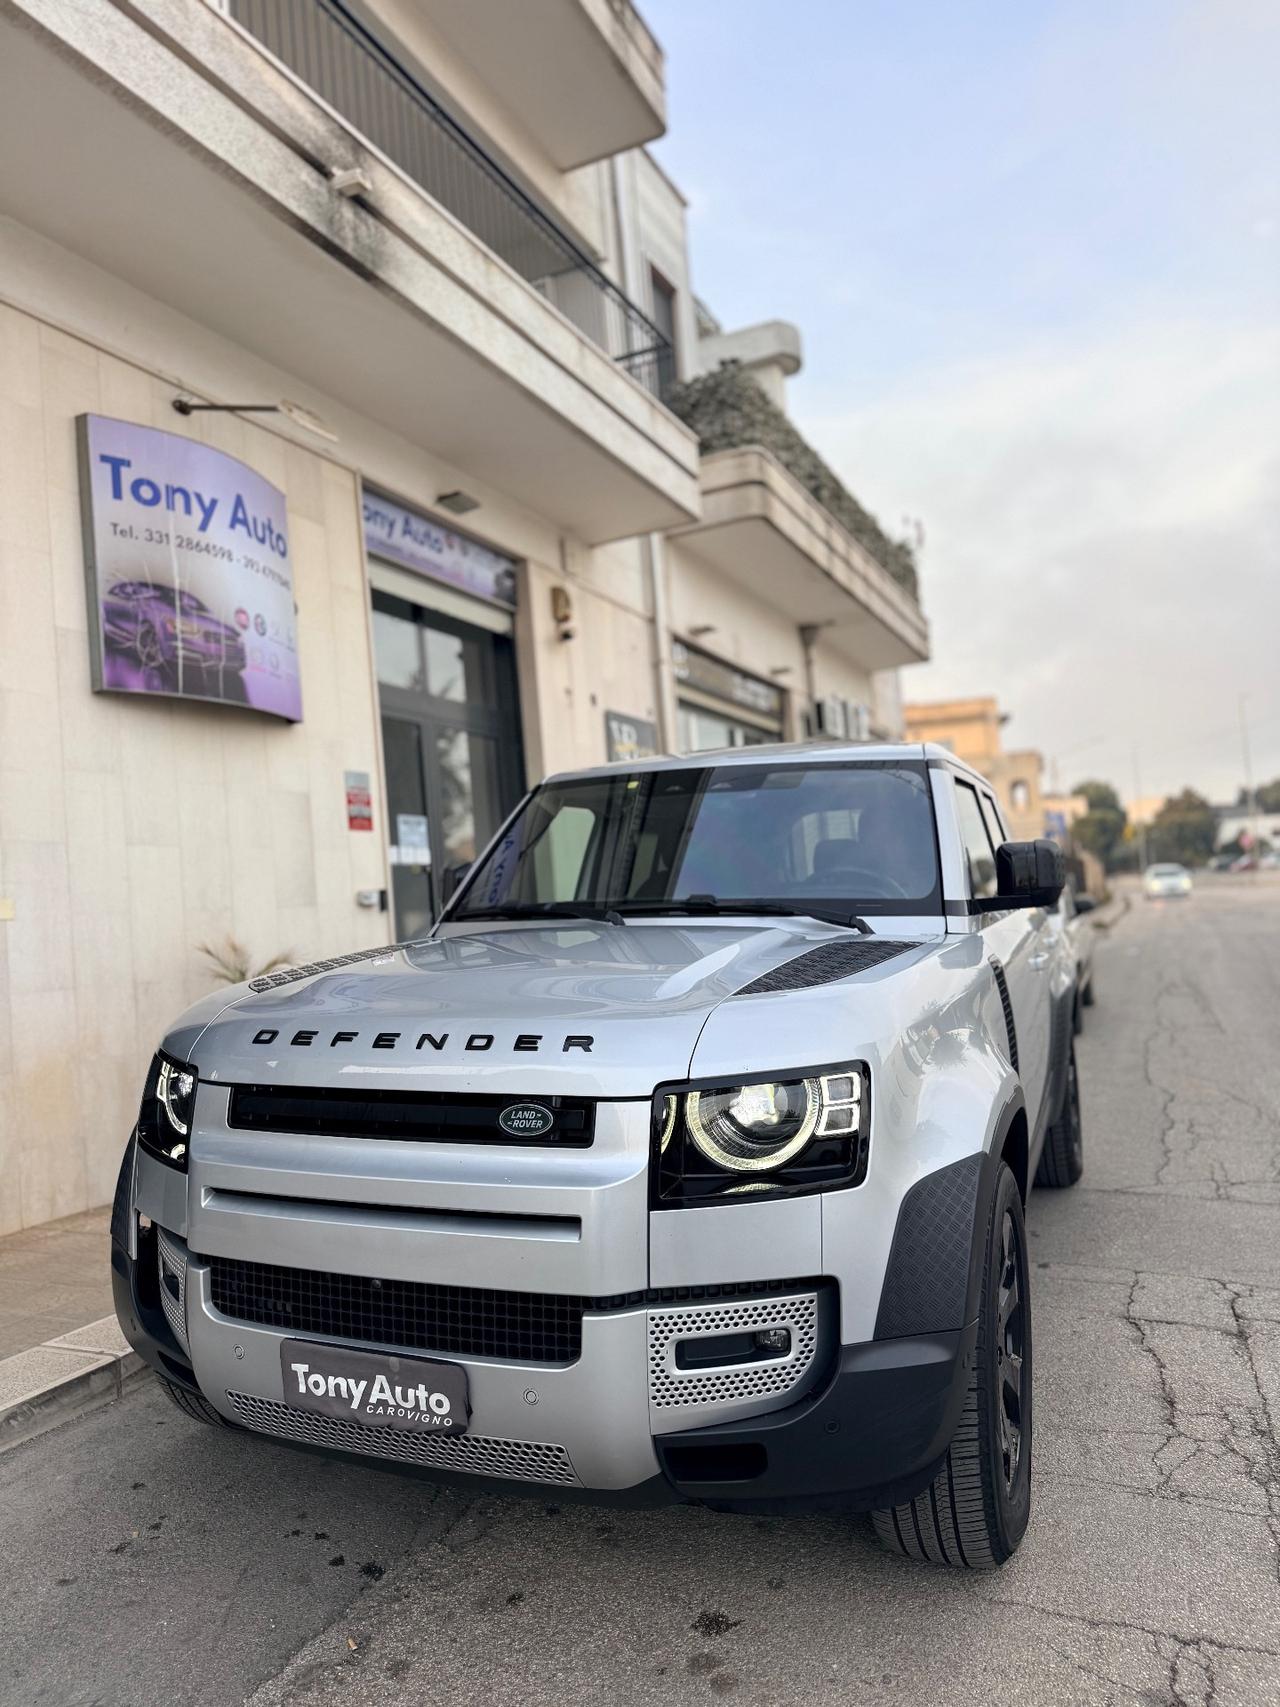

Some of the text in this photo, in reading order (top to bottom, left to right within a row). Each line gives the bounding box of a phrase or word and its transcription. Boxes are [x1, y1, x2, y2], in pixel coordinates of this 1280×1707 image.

[99, 454, 287, 559] Tony Auto
[110, 523, 138, 541] Tel.
[363, 504, 443, 554] ony Auto
[252, 1029, 594, 1052] DEFENDER
[511, 1110, 536, 1120] LAND
[512, 1119, 543, 1129] ROVER
[366, 1405, 453, 1427] CAROVIGNO
